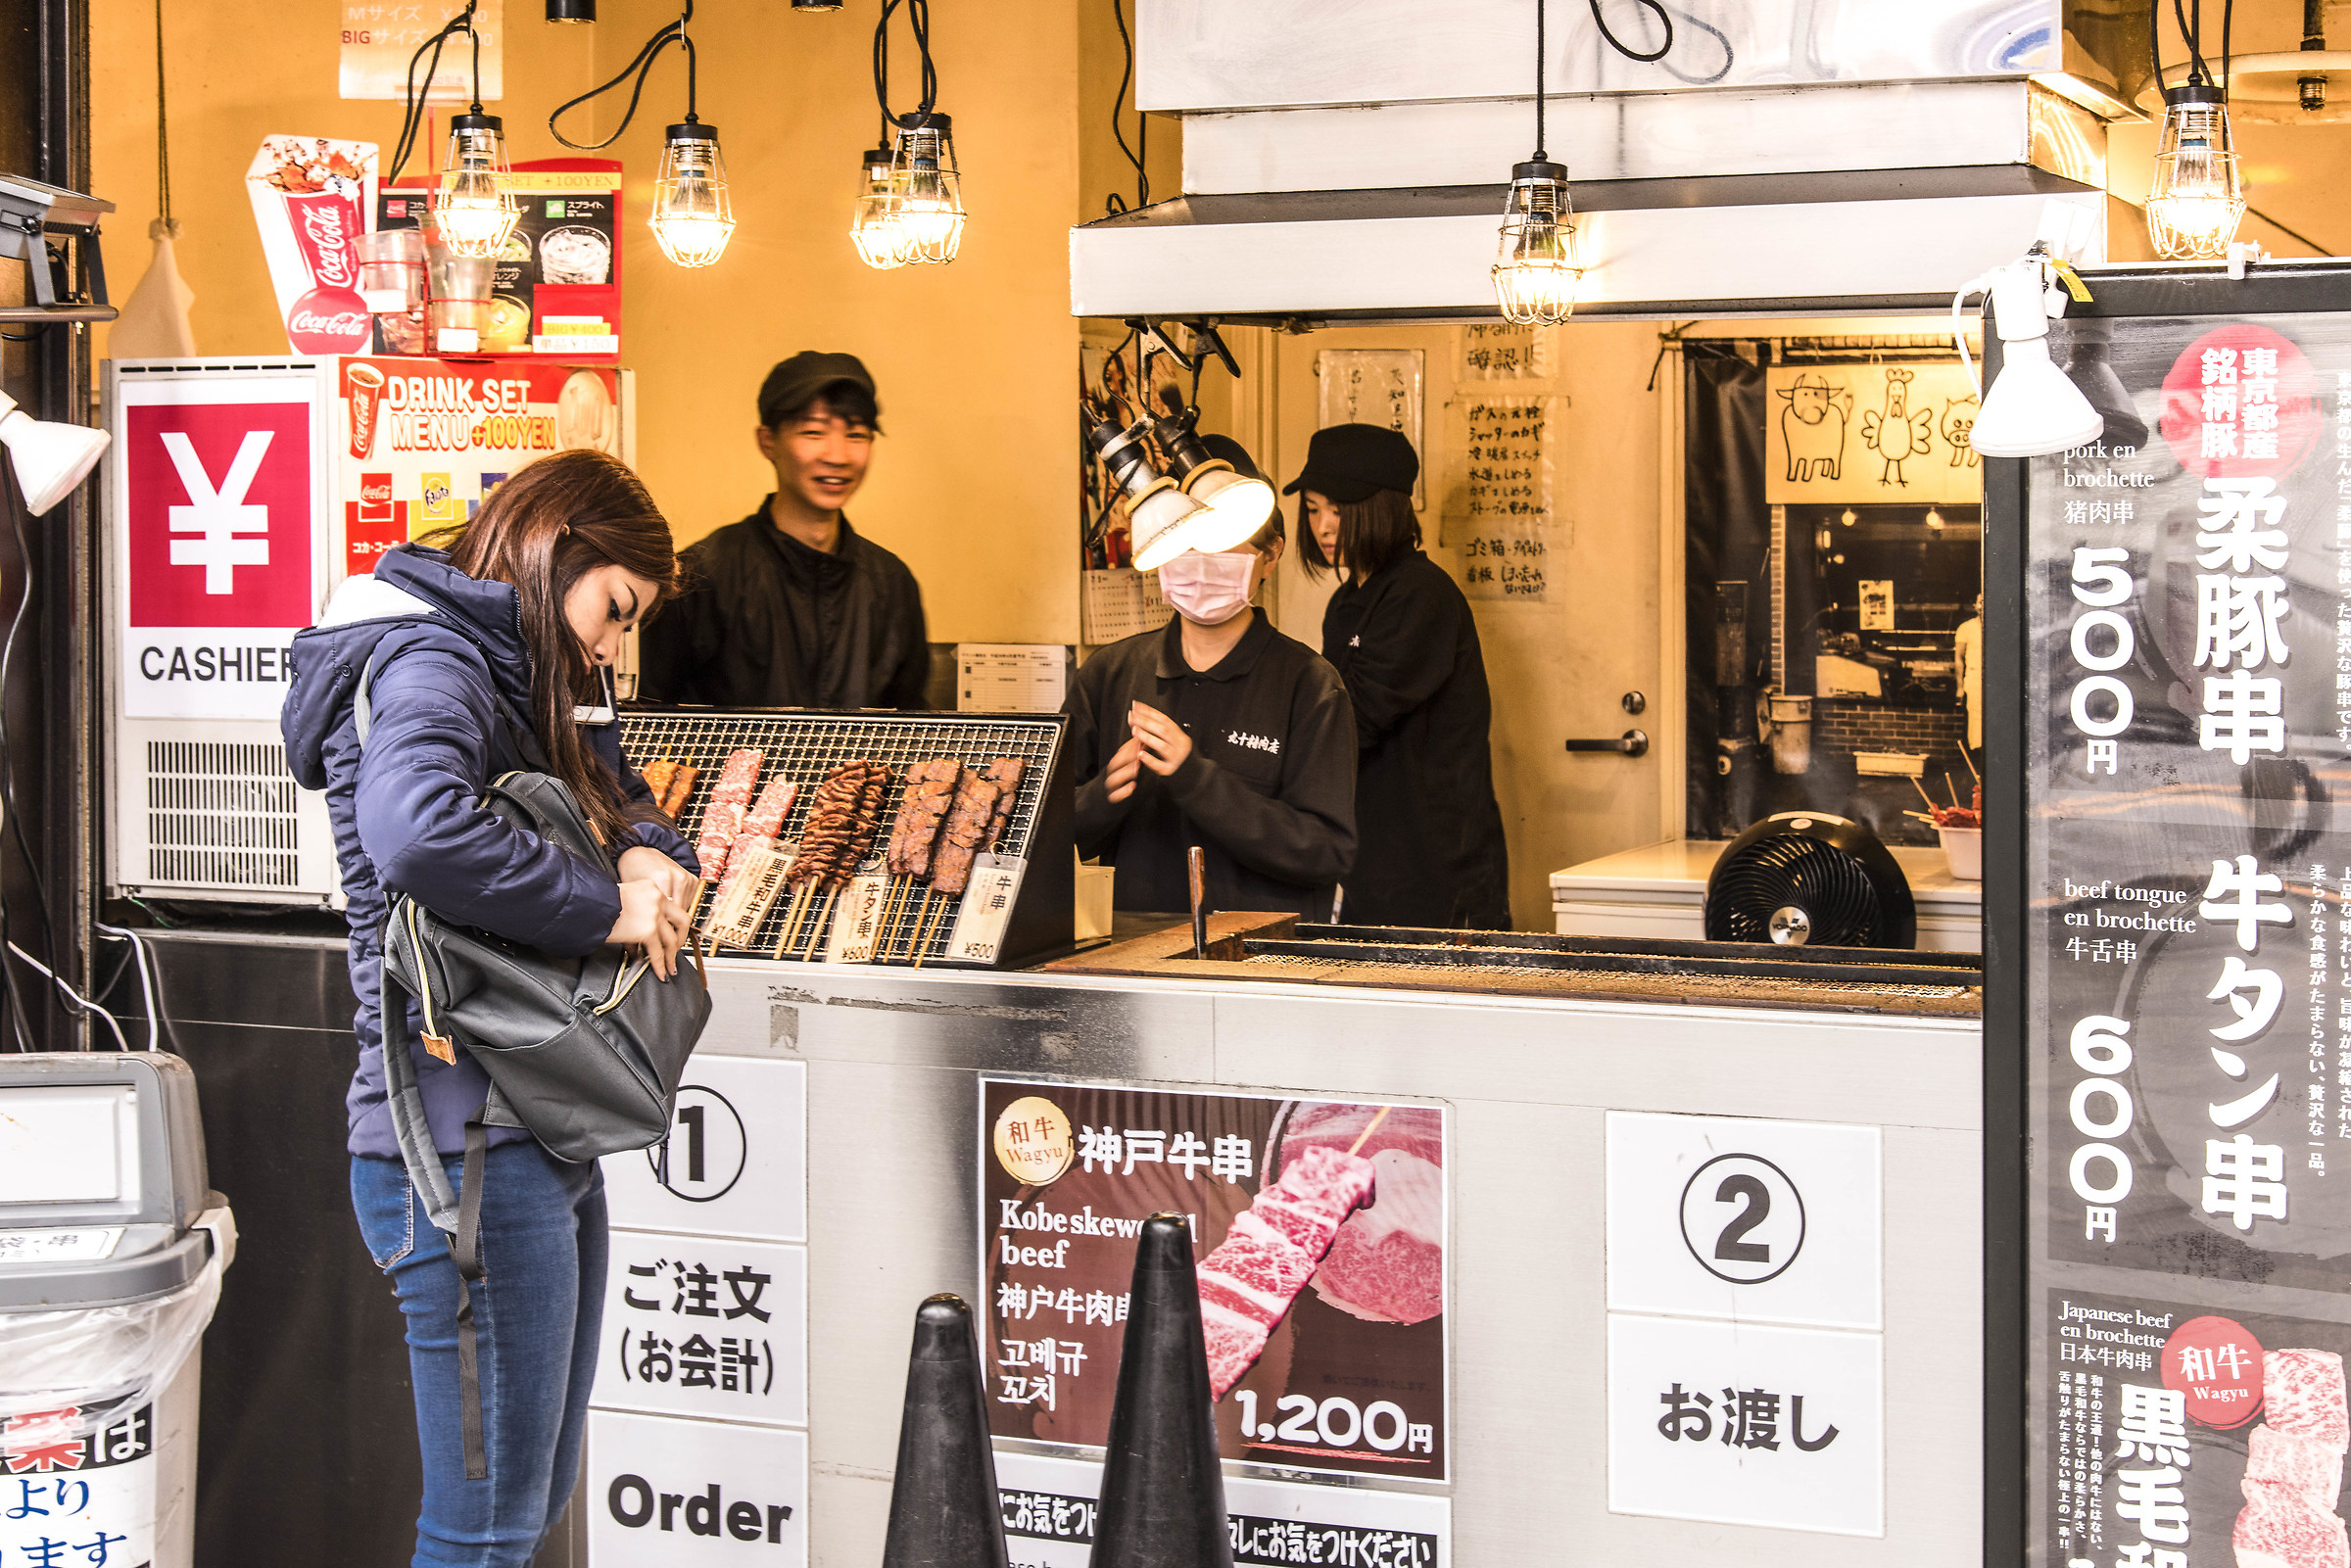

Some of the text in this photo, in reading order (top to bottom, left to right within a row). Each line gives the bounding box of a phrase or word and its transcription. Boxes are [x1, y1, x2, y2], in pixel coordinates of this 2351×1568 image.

[291, 310, 368, 336] Coca-Cola
[388, 376, 531, 413] DRINK SET
[2200, 347, 2238, 458] 銘柄豚
[2240, 347, 2279, 459] 東京都産
[392, 413, 555, 451] MENU +100YEN
[2063, 439, 2137, 465] pork en
[2063, 468, 2155, 488] brochette
[2063, 499, 2134, 525] 猪肉串
[2192, 476, 2290, 766] 柔豚串
[2070, 546, 2135, 776] 500円
[737, 857, 788, 929] 黒毛和牛串
[990, 875, 1012, 911] 牛串
[2064, 878, 2187, 909] beef tongue
[710, 923, 748, 944] ¥1,000
[2064, 908, 2197, 933] en brochette
[841, 946, 870, 960] ¥600
[964, 941, 994, 959] ¥500
[2064, 936, 2137, 965] 牛舌串
[2198, 854, 2293, 1231] 牛タン串
[1008, 1116, 1055, 1145] 和牛
[2069, 1015, 2135, 1244] 600円
[1006, 1146, 1064, 1165] Wagyu
[1078, 1124, 1254, 1185] 神戸牛串
[999, 1199, 1199, 1244] Kobe skew
[999, 1235, 1071, 1269] beef
[624, 1258, 772, 1324] ご注文
[2058, 1301, 2173, 1329] Japanese beef
[2060, 1322, 2166, 1349] en brochette
[619, 1326, 774, 1396] （お会計）
[997, 1337, 1089, 1377] 고베규
[2059, 1343, 2153, 1372] 日本牛肉串
[2178, 1343, 2253, 1383] 和牛
[997, 1374, 1057, 1412] 꼬치
[2192, 1386, 2249, 1402] Wagyu
[1234, 1390, 1434, 1453] 1,200円
[1657, 1382, 1841, 1453] お渡し
[607, 1473, 792, 1544] Order
